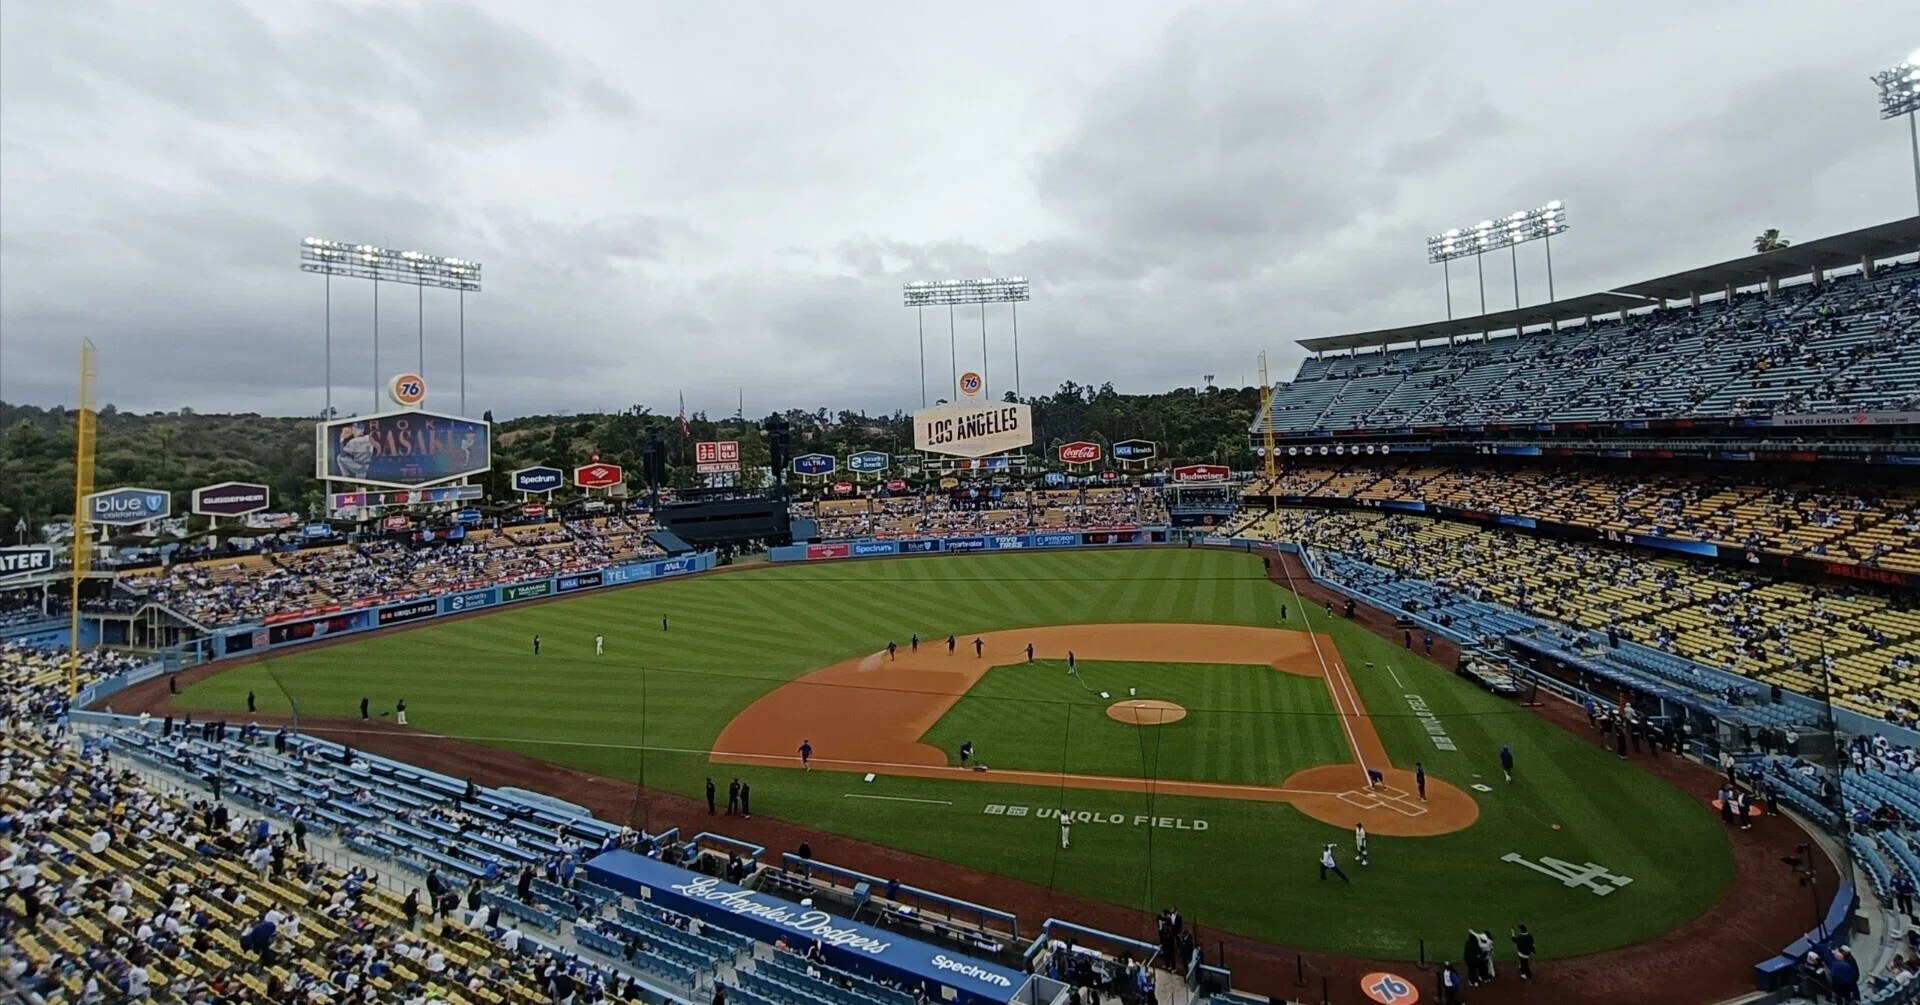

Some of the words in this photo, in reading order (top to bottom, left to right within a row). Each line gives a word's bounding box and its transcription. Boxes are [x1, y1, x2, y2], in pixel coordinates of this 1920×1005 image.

[964, 377, 977, 389] 76
[401, 382, 420, 397] 76
[927, 418, 953, 446] LOS
[957, 407, 1018, 441] ANGELES
[370, 429, 454, 457] SASAKI
[1116, 447, 1131, 455] UCLA
[863, 455, 885, 463] Security
[520, 475, 556, 485] Spectrum
[1180, 472, 1224, 480] Budweiser
[96, 497, 141, 513] blue
[855, 545, 890, 555] Spectrum
[908, 542, 924, 550] blue
[663, 563, 681, 571] ANA
[607, 570, 629, 581] TEL
[562, 580, 577, 589] UCLA
[579, 576, 600, 586] Health
[465, 592, 487, 602] Security
[465, 599, 485, 608] Benefit
[393, 606, 417, 618] UNIQLO
[417, 604, 436, 614] FIELD
[1035, 807, 1125, 824] UNIQLO
[1133, 815, 1209, 831] FIELD
[1500, 852, 1634, 896] LA
[671, 876, 711, 898] Los
[703, 889, 796, 926] Angeles
[786, 910, 892, 955] Dodgers
[931, 954, 1004, 988] Spectrum
[1371, 976, 1408, 1002] 76
